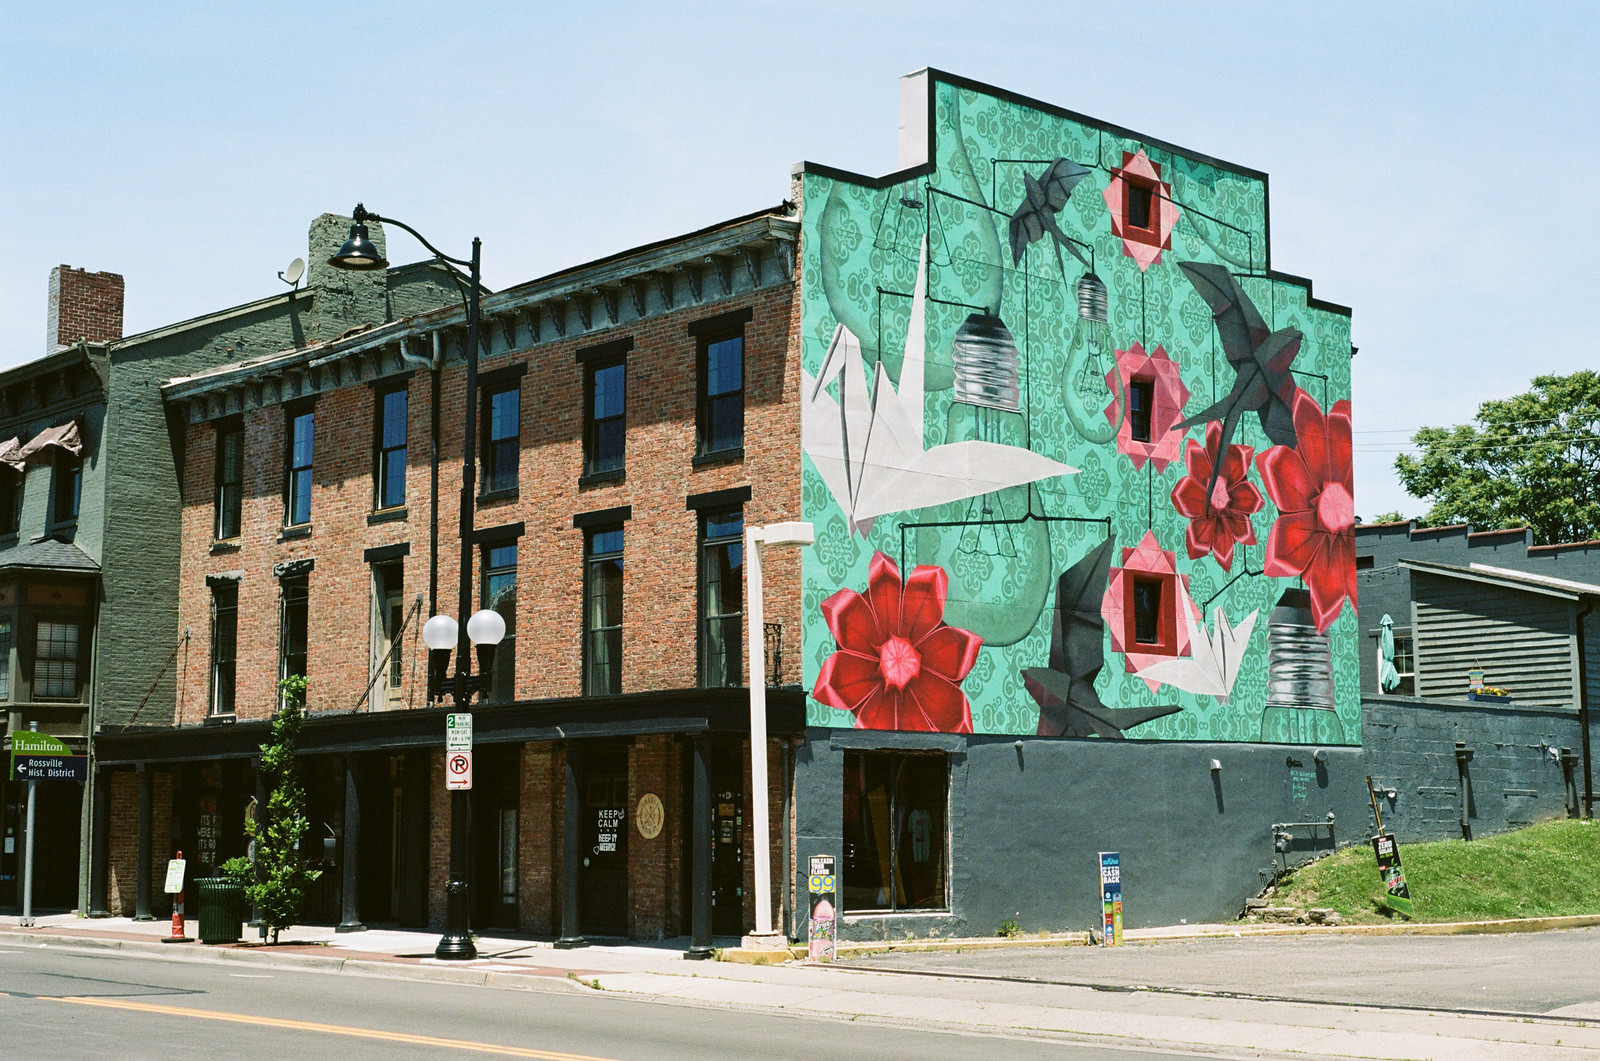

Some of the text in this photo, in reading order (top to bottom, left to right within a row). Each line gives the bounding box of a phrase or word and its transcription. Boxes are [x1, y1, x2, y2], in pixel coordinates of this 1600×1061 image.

[448, 716, 454, 727] 2
[15, 740, 63, 751] Hamilton
[28, 759, 63, 767] Rossville
[28, 769, 75, 777] Hist. District
[598, 810, 618, 819] KEEP
[598, 819, 618, 828] CALM
[598, 834, 611, 842] KEEP
[1378, 840, 1393, 849] ZERO
[811, 875, 834, 893] 99
[1103, 876, 1120, 884] BACK
